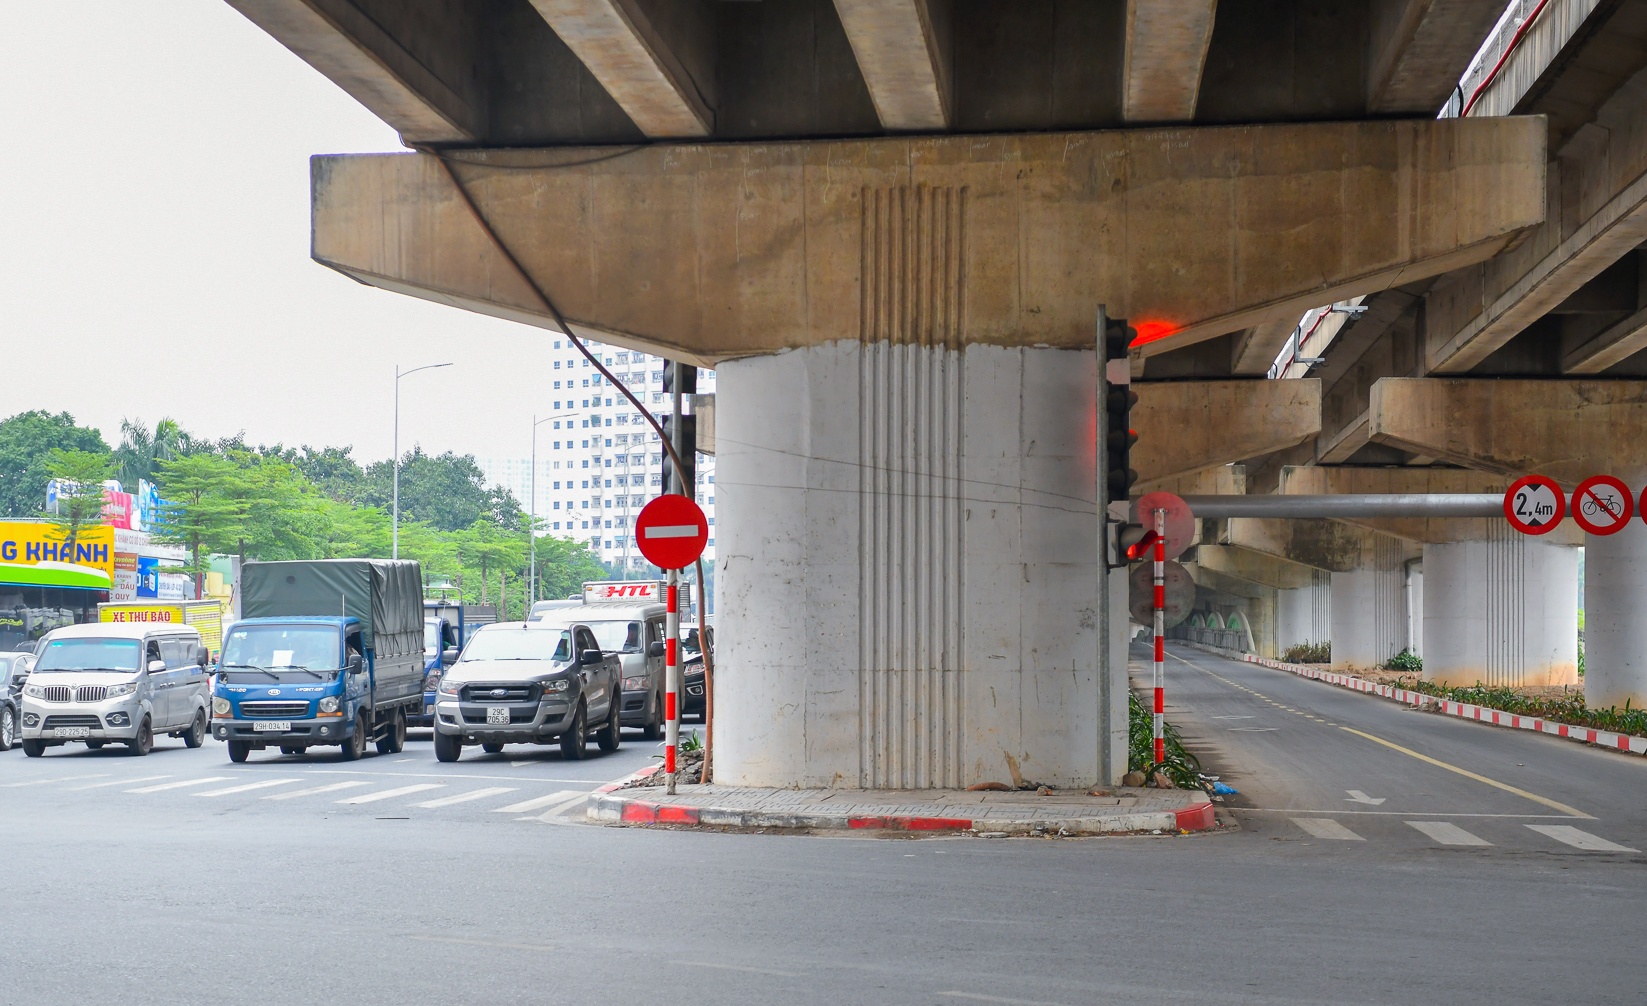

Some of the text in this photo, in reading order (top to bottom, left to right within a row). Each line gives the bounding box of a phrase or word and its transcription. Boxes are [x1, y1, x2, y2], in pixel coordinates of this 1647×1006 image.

[1516, 492, 1553, 517] 2,4m
[606, 585, 651, 598] HTL
[112, 611, 126, 623] XE
[129, 610, 148, 623] THƯ
